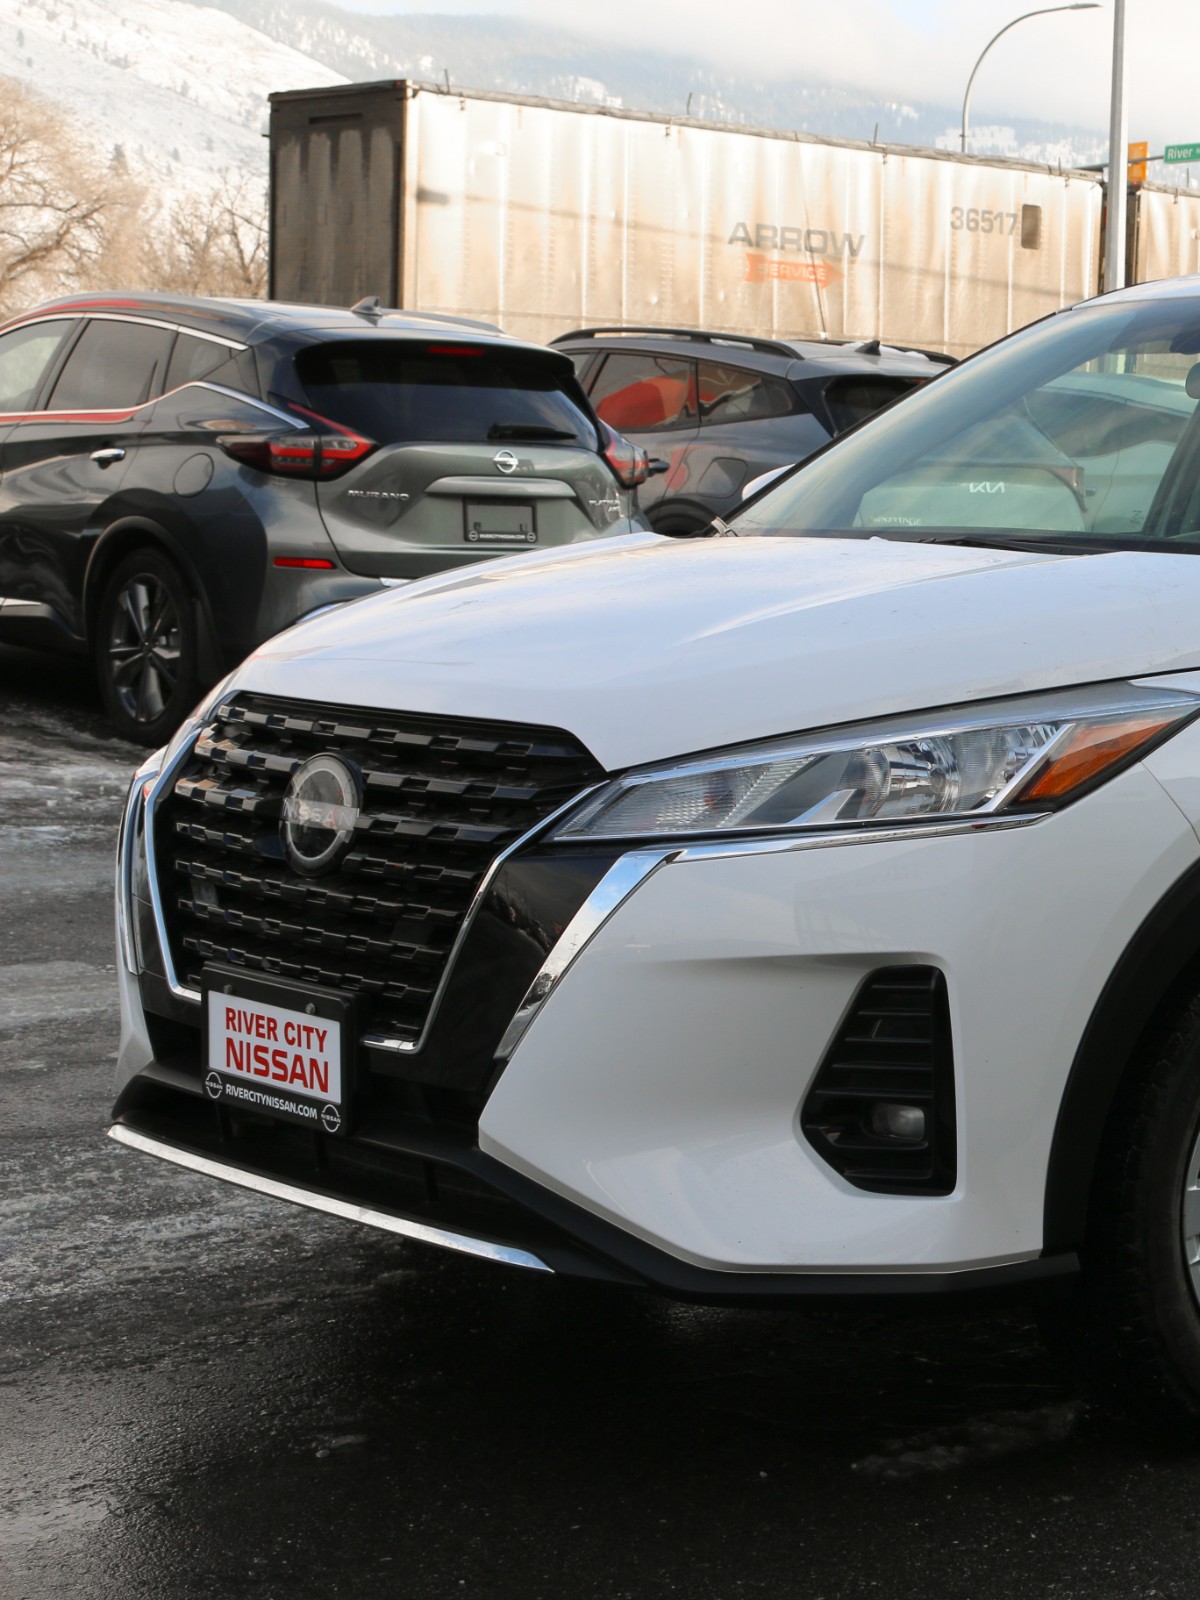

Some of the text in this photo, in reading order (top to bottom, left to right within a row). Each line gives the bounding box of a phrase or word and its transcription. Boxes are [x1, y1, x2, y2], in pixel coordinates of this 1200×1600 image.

[1167, 146, 1193, 160] River
[949, 205, 1019, 236] 36517
[728, 221, 866, 257] ARROW
[757, 261, 827, 281] SERVICE
[347, 489, 410, 502] MURANO
[225, 1006, 328, 1053] RIVER CITY
[226, 1036, 329, 1094] NISSAN
[205, 1080, 223, 1090] NISSAN
[226, 1083, 318, 1120] RIVERCITYNISSAN.COM
[321, 1113, 341, 1123] NISSAN
